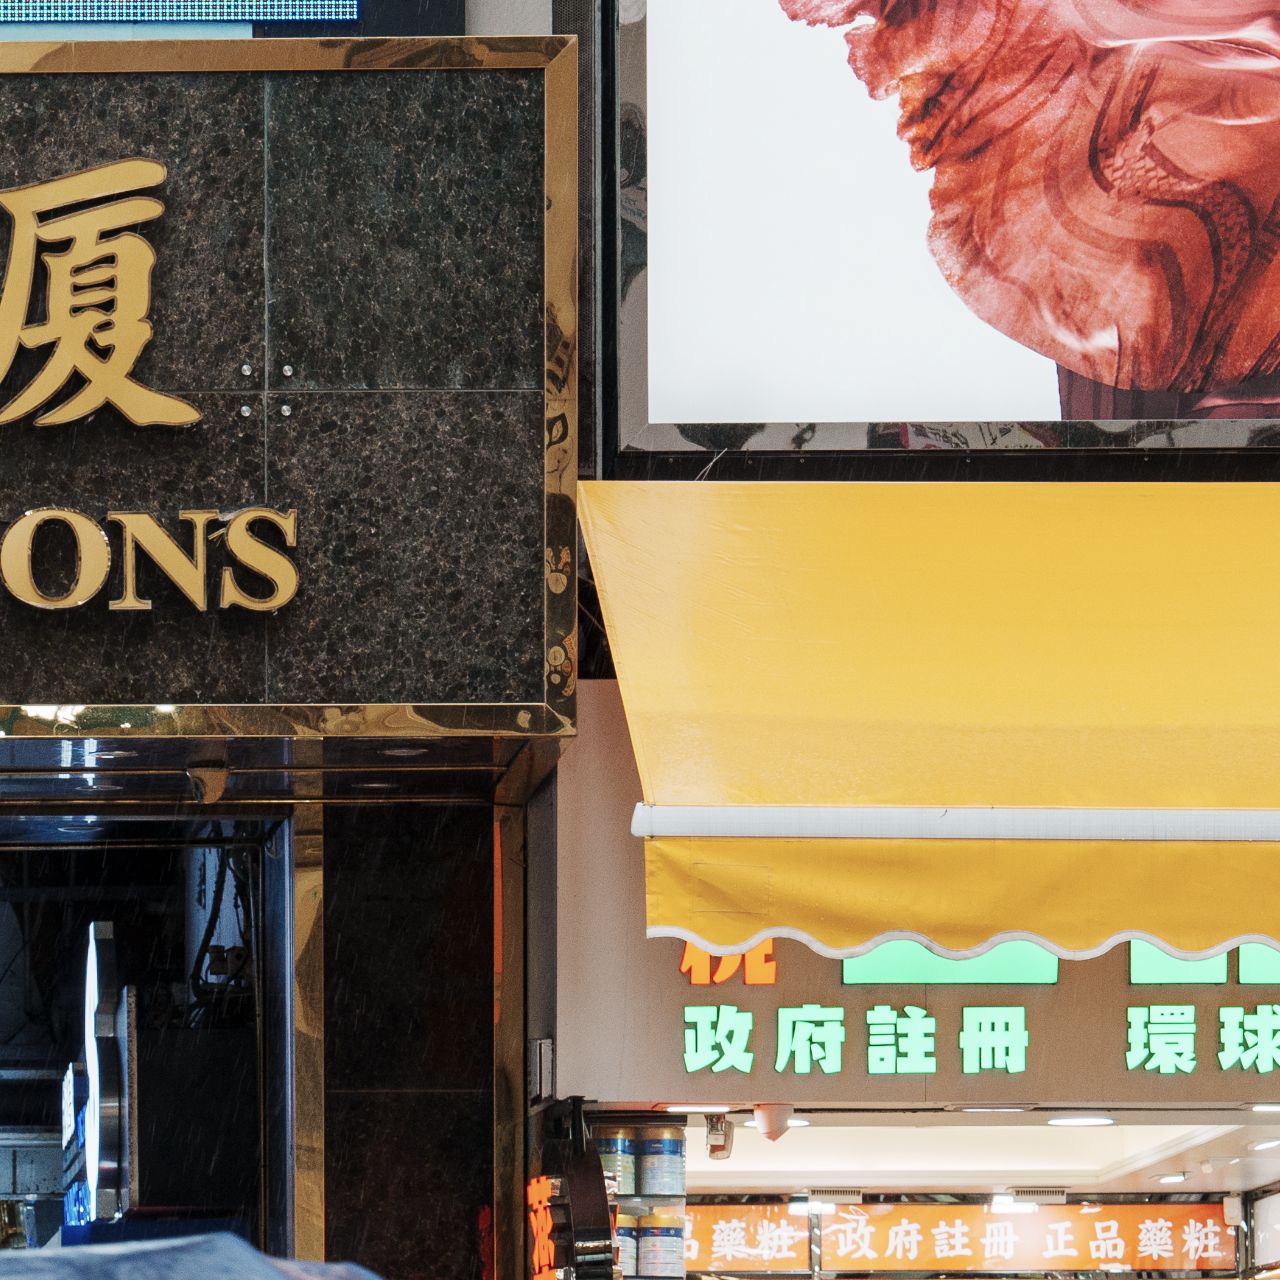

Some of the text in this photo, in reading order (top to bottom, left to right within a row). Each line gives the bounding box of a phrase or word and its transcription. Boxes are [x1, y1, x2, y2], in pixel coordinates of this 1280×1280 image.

[683, 1003, 1030, 1076] 政府註冊
[1124, 1003, 1280, 1076] 環球
[837, 1218, 1223, 1261] 政府註冊 正品藥粧
